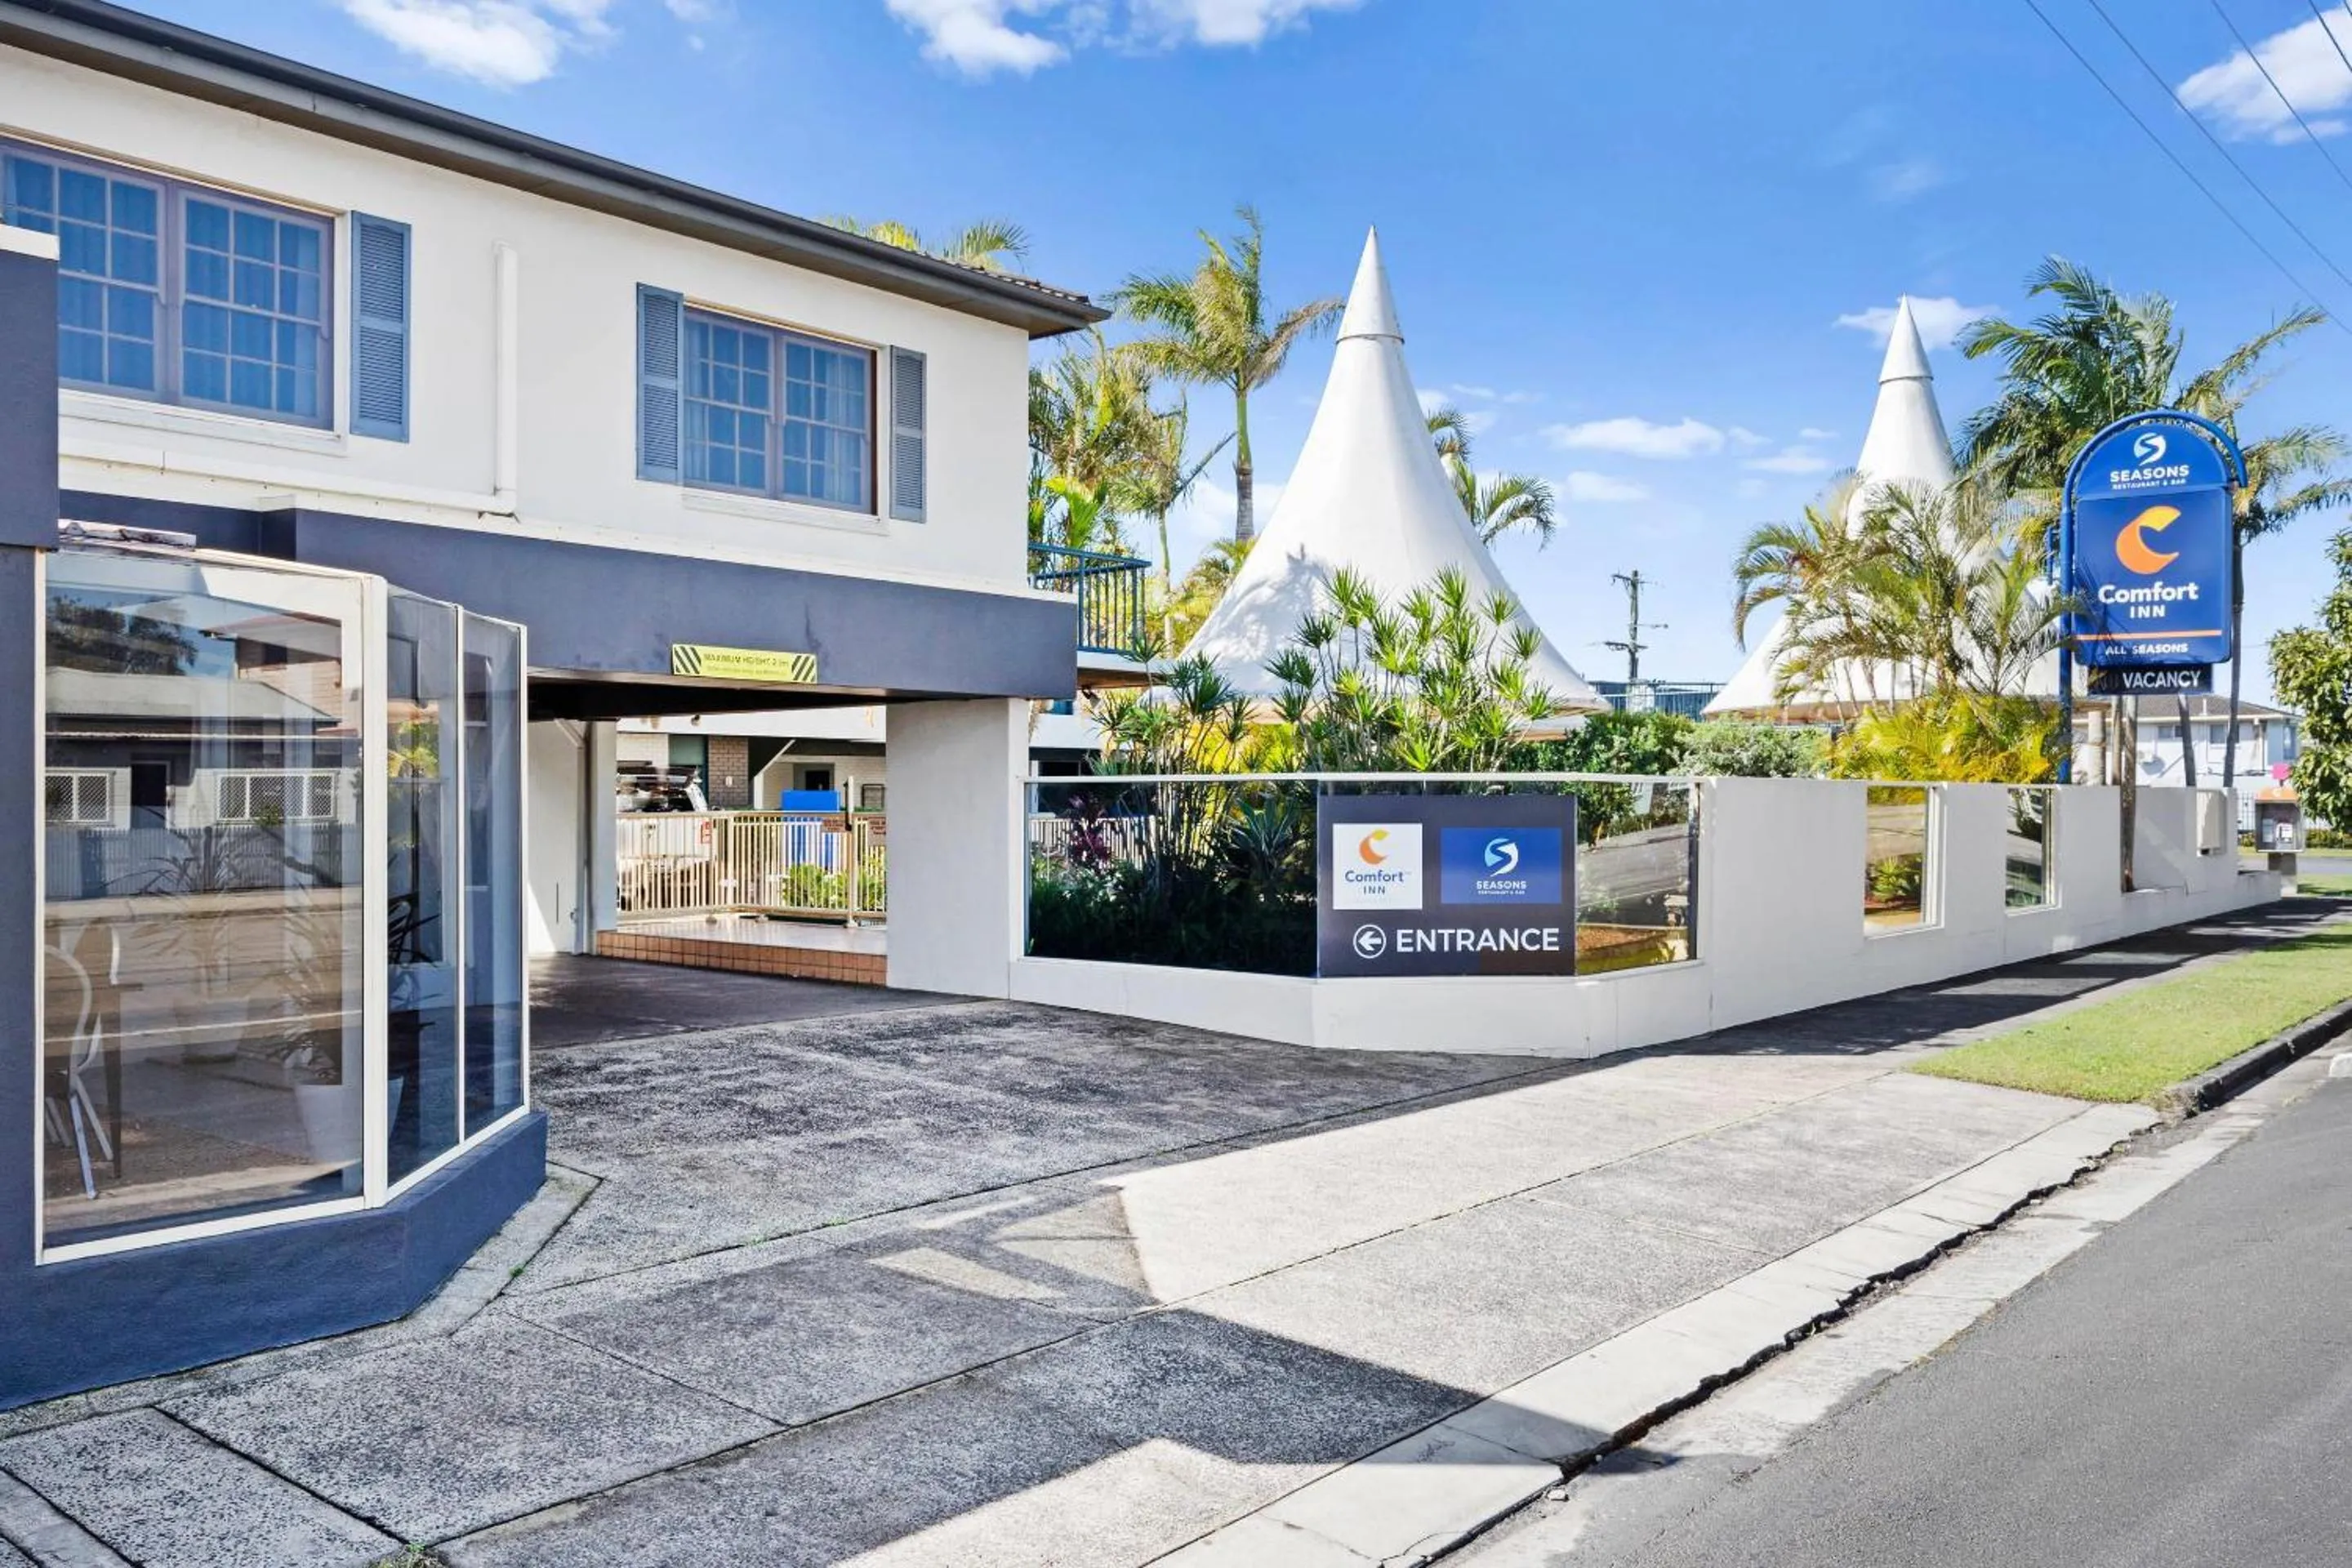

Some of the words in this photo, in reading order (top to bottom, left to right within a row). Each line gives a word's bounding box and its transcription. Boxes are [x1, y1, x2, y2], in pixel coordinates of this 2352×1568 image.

[2109, 464, 2189, 483] SEASONS
[2098, 581, 2199, 604] Comfort
[2129, 604, 2166, 619] INN
[2105, 645, 2127, 655] ALL
[2132, 643, 2189, 654] SEASONS
[703, 653, 742, 664] MAXIMUM
[2123, 670, 2201, 688] VACANCY
[1345, 870, 1404, 883] Comfort
[1363, 885, 1386, 895] INN
[1476, 880, 1527, 890] SEASONS
[1396, 928, 1560, 952] ENTRANCE
